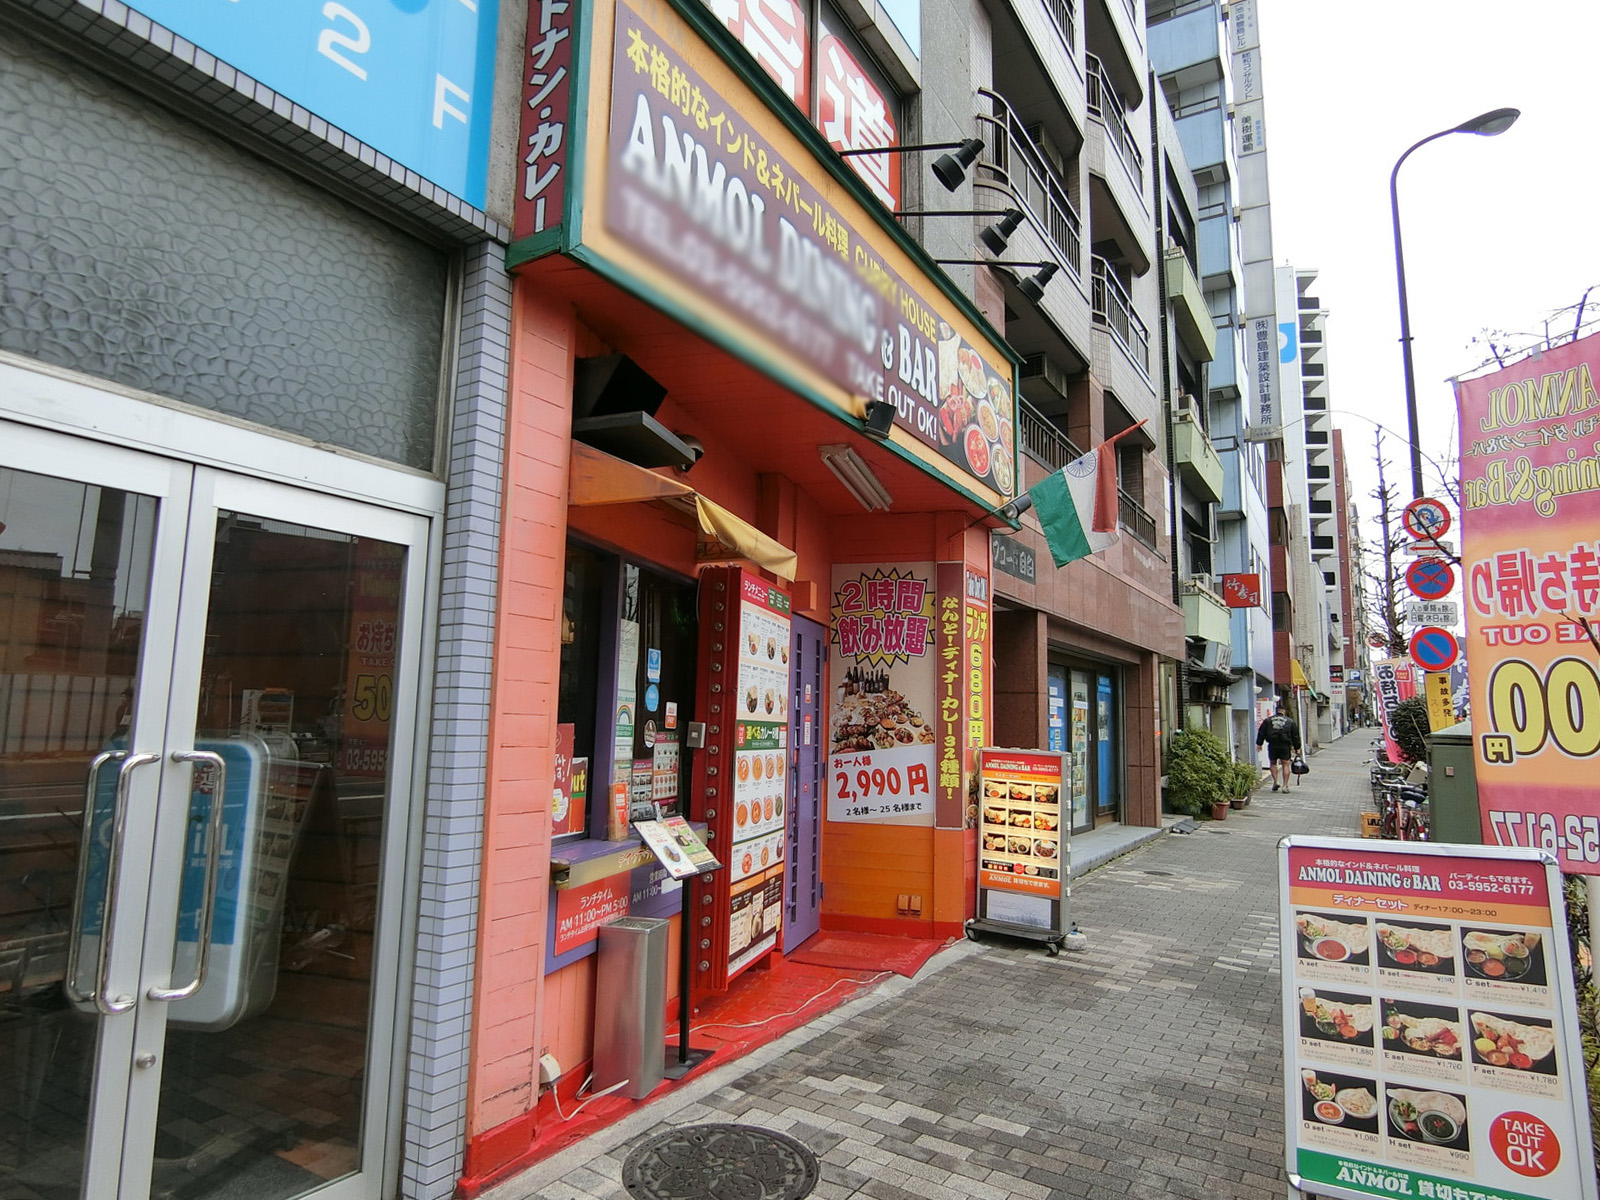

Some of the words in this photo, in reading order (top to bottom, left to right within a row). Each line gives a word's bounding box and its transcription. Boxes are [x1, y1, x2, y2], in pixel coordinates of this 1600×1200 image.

[620, 93, 772, 273] ANMOL
[898, 322, 939, 407] BAR
[900, 288, 937, 344] HOUSE
[888, 385, 916, 426] OUT
[917, 406, 938, 441] OK!
[841, 578, 927, 613] 2時間
[838, 614, 929, 657] 飲み放題
[966, 606, 988, 643] ランチ
[968, 642, 985, 749] 680円
[1438, 676, 1453, 718] 事故多発
[834, 755, 871, 769] お一人様
[1298, 865, 1343, 885] ANMOL
[1344, 869, 1401, 889] DAINING
[1403, 877, 1411, 889] &
[1412, 874, 1442, 892] BAR
[1448, 879, 1534, 895] 03-5952-6177
[580, 887, 613, 909] ランチタイム
[1332, 893, 1409, 911] ディナーセット
[560, 917, 573, 933] AM
[1475, 980, 1491, 988] set
[1309, 1040, 1322, 1048] set
[1482, 1068, 1496, 1076] set
[1312, 1124, 1325, 1132] set
[1501, 1117, 1546, 1138] TAKE
[1398, 1141, 1412, 1149] set
[1506, 1132, 1542, 1149] OUT
[1506, 1146, 1546, 1171] OK
[1335, 1167, 1412, 1196] ANMOL
